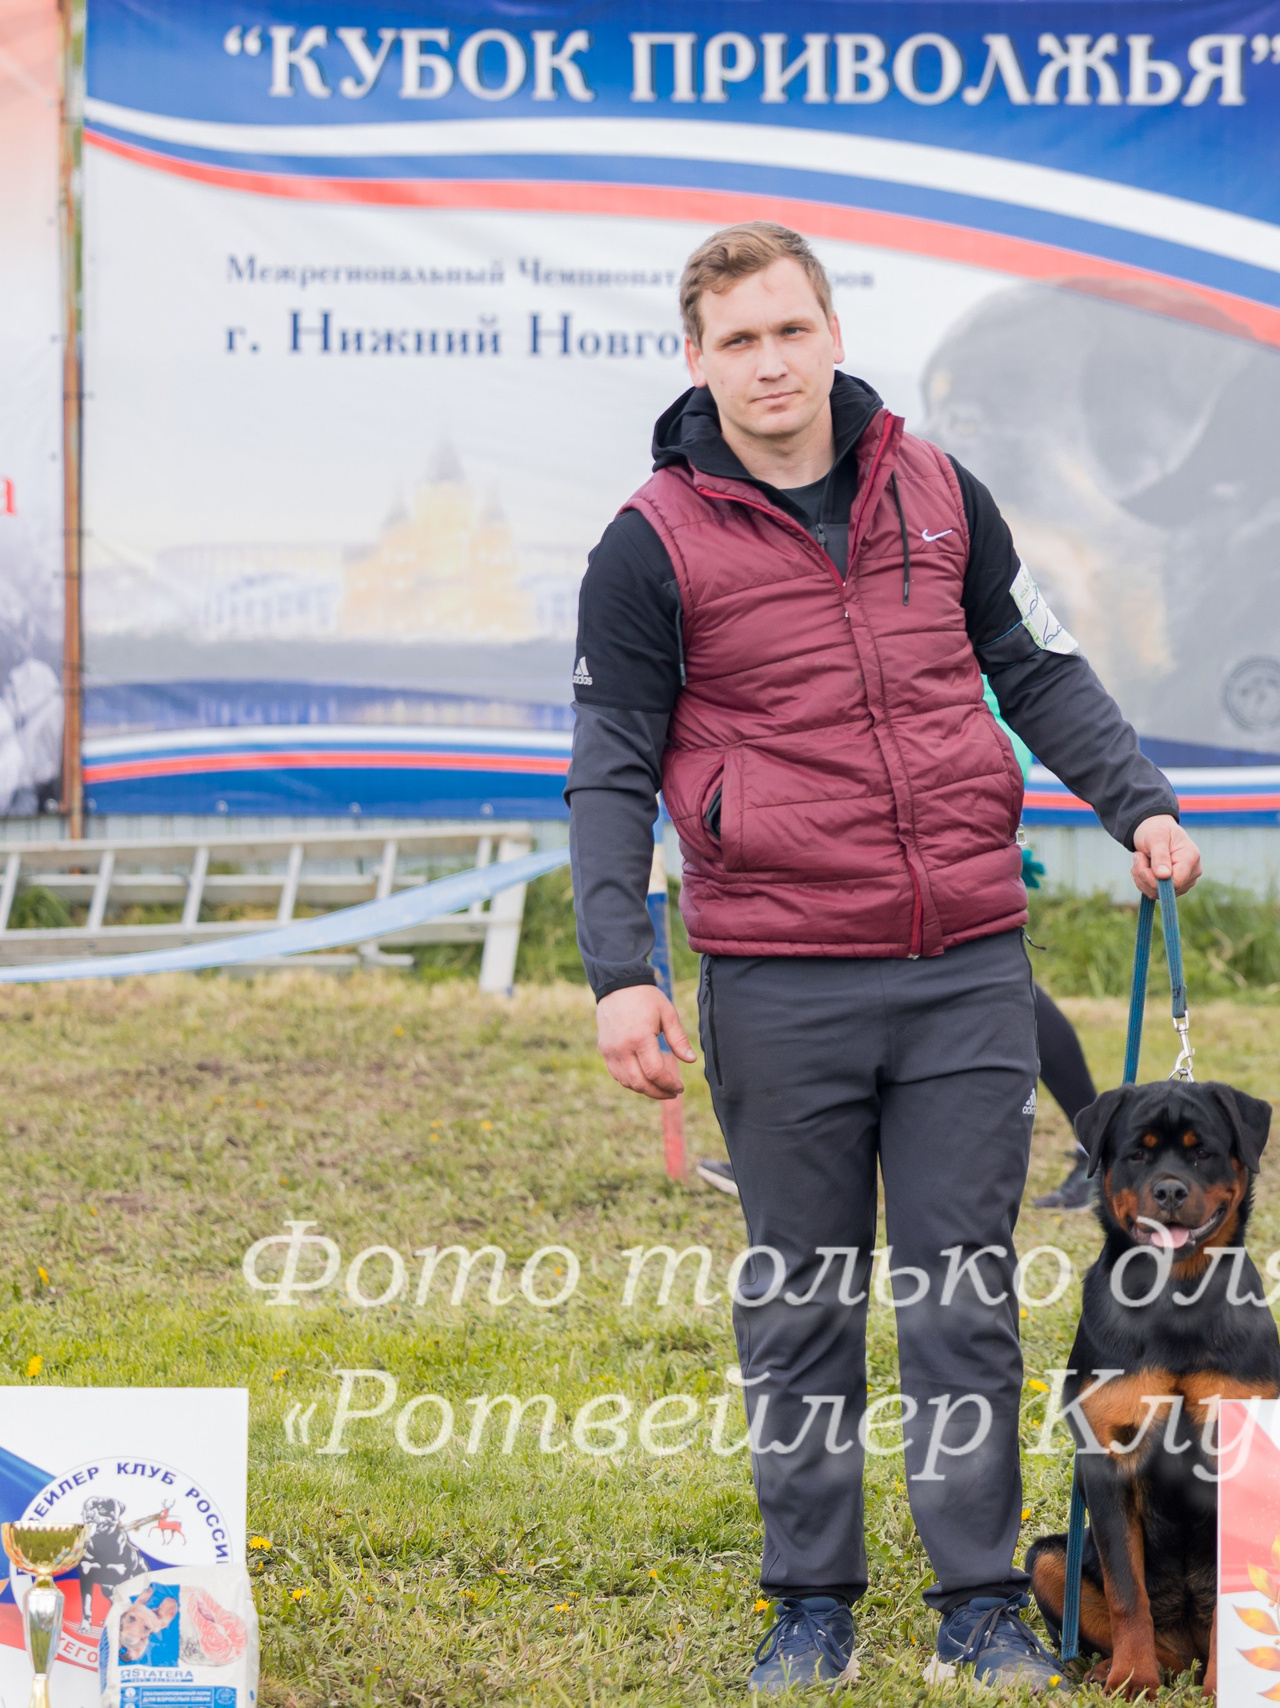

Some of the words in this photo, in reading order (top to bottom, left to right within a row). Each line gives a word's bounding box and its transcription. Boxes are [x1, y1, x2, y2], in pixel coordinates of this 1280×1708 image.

[223, 25, 596, 101] “КУБОК
[227, 254, 505, 290] Межрегиональный
[519, 257, 676, 289] Чемпионат
[226, 326, 259, 353] г.
[289, 308, 502, 355] Нижний
[528, 311, 682, 358] Новго
[116, 1462, 177, 1486] КЛУБ
